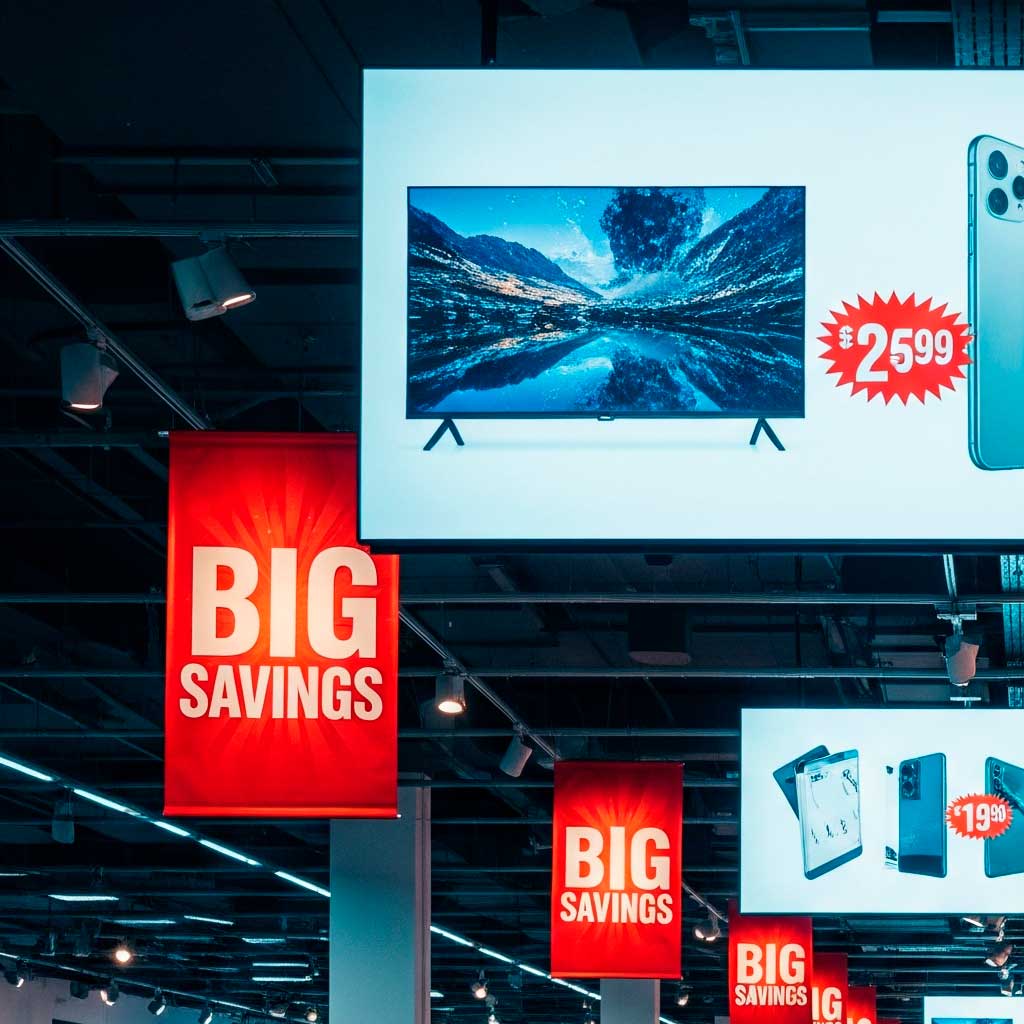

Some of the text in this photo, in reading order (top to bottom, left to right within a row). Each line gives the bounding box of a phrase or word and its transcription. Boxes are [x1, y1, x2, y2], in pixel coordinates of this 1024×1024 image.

[192, 547, 377, 659] BIG
[180, 663, 382, 720] SAVINGS
[565, 826, 670, 891] BIG
[560, 892, 673, 924] SAVINGS
[737, 943, 805, 984] BIG
[735, 983, 807, 1005] SAVINGS
[812, 987, 842, 1021] IG
